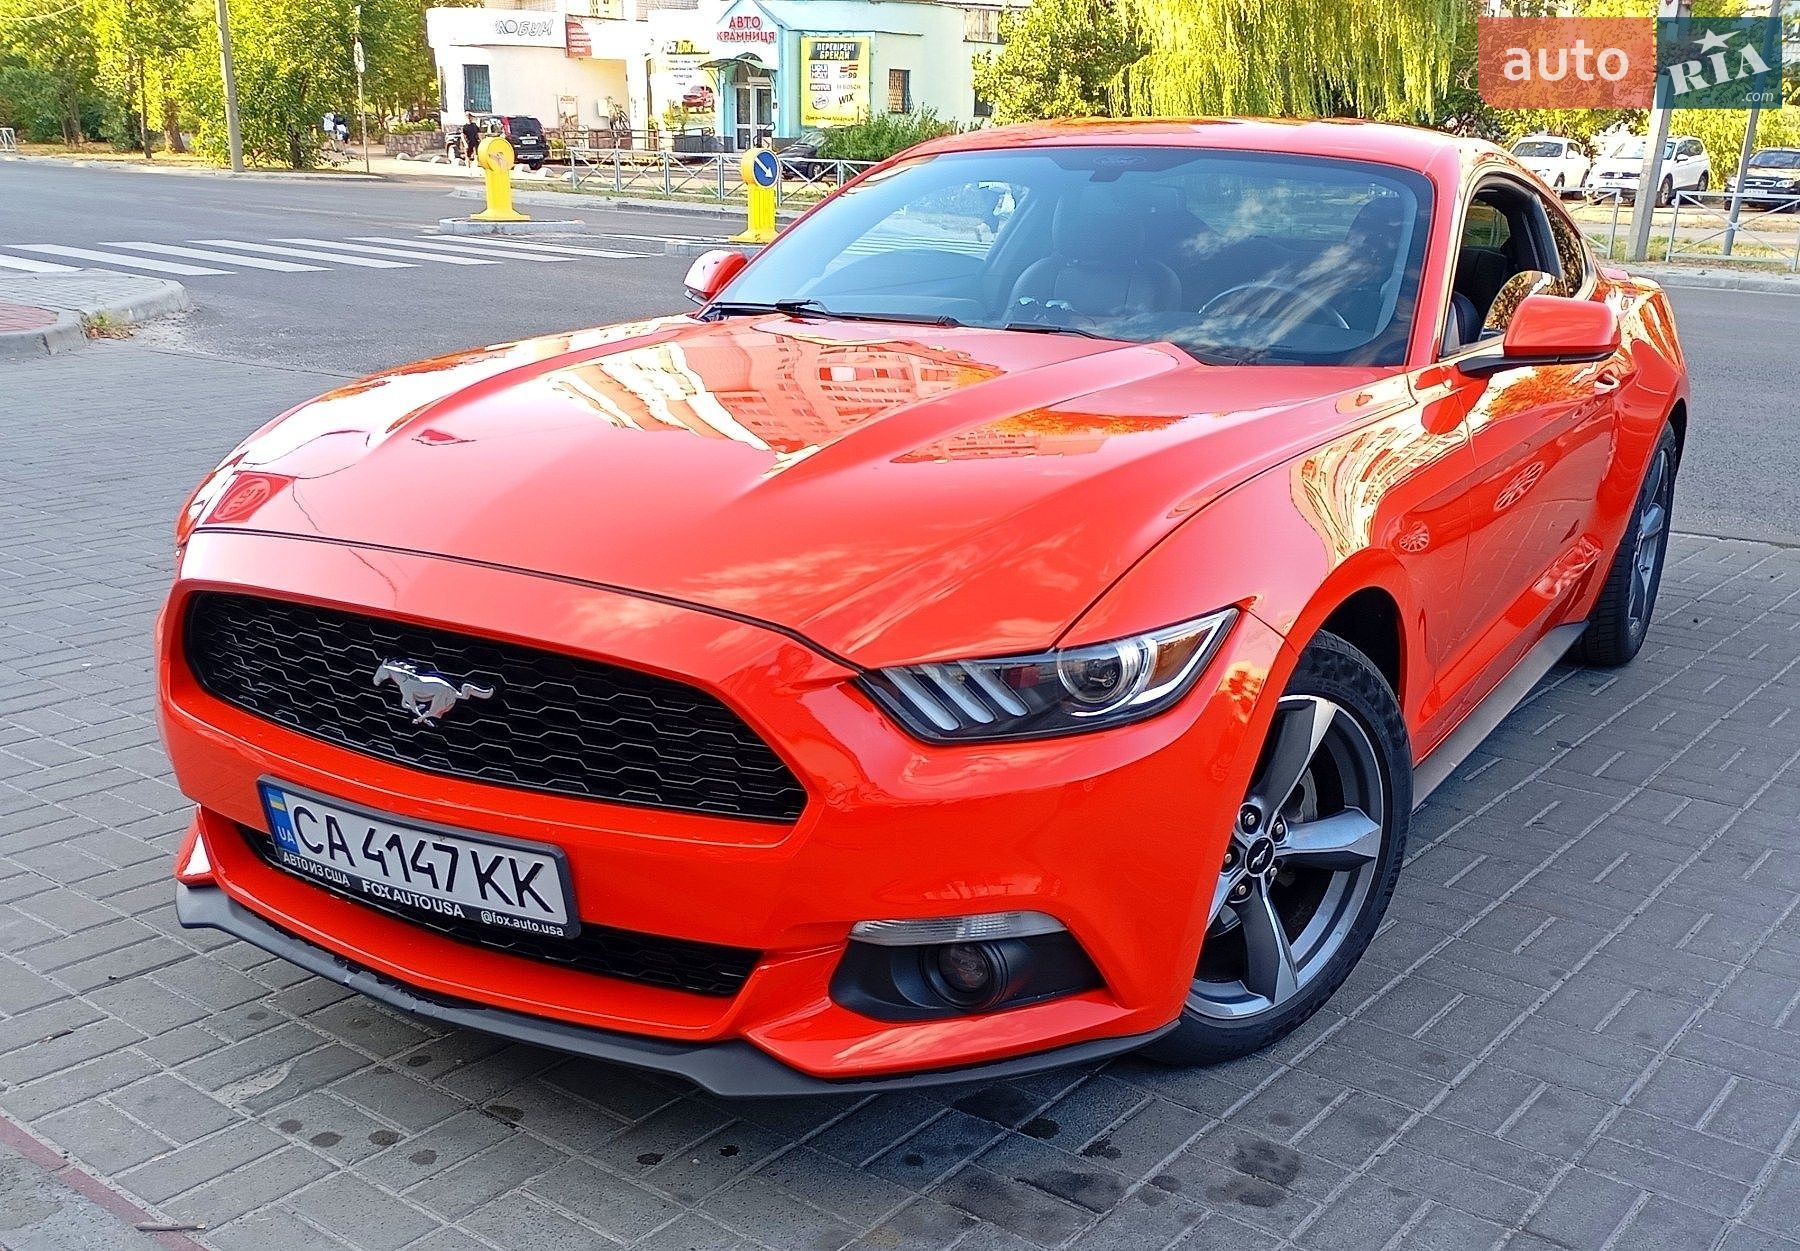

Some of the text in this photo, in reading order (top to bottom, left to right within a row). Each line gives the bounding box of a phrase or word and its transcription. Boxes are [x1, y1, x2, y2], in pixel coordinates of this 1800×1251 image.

[728, 16, 762, 29] АВТО
[716, 31, 776, 43] КРАМНИЦЯ
[819, 51, 850, 60] БРЕНДИ
[838, 93, 854, 104] WIX
[277, 826, 296, 845] UA
[293, 805, 556, 914] CA 4147 KK
[324, 866, 351, 888] США
[362, 879, 392, 901] FOX
[480, 910, 565, 937] @fox.auto.usa
